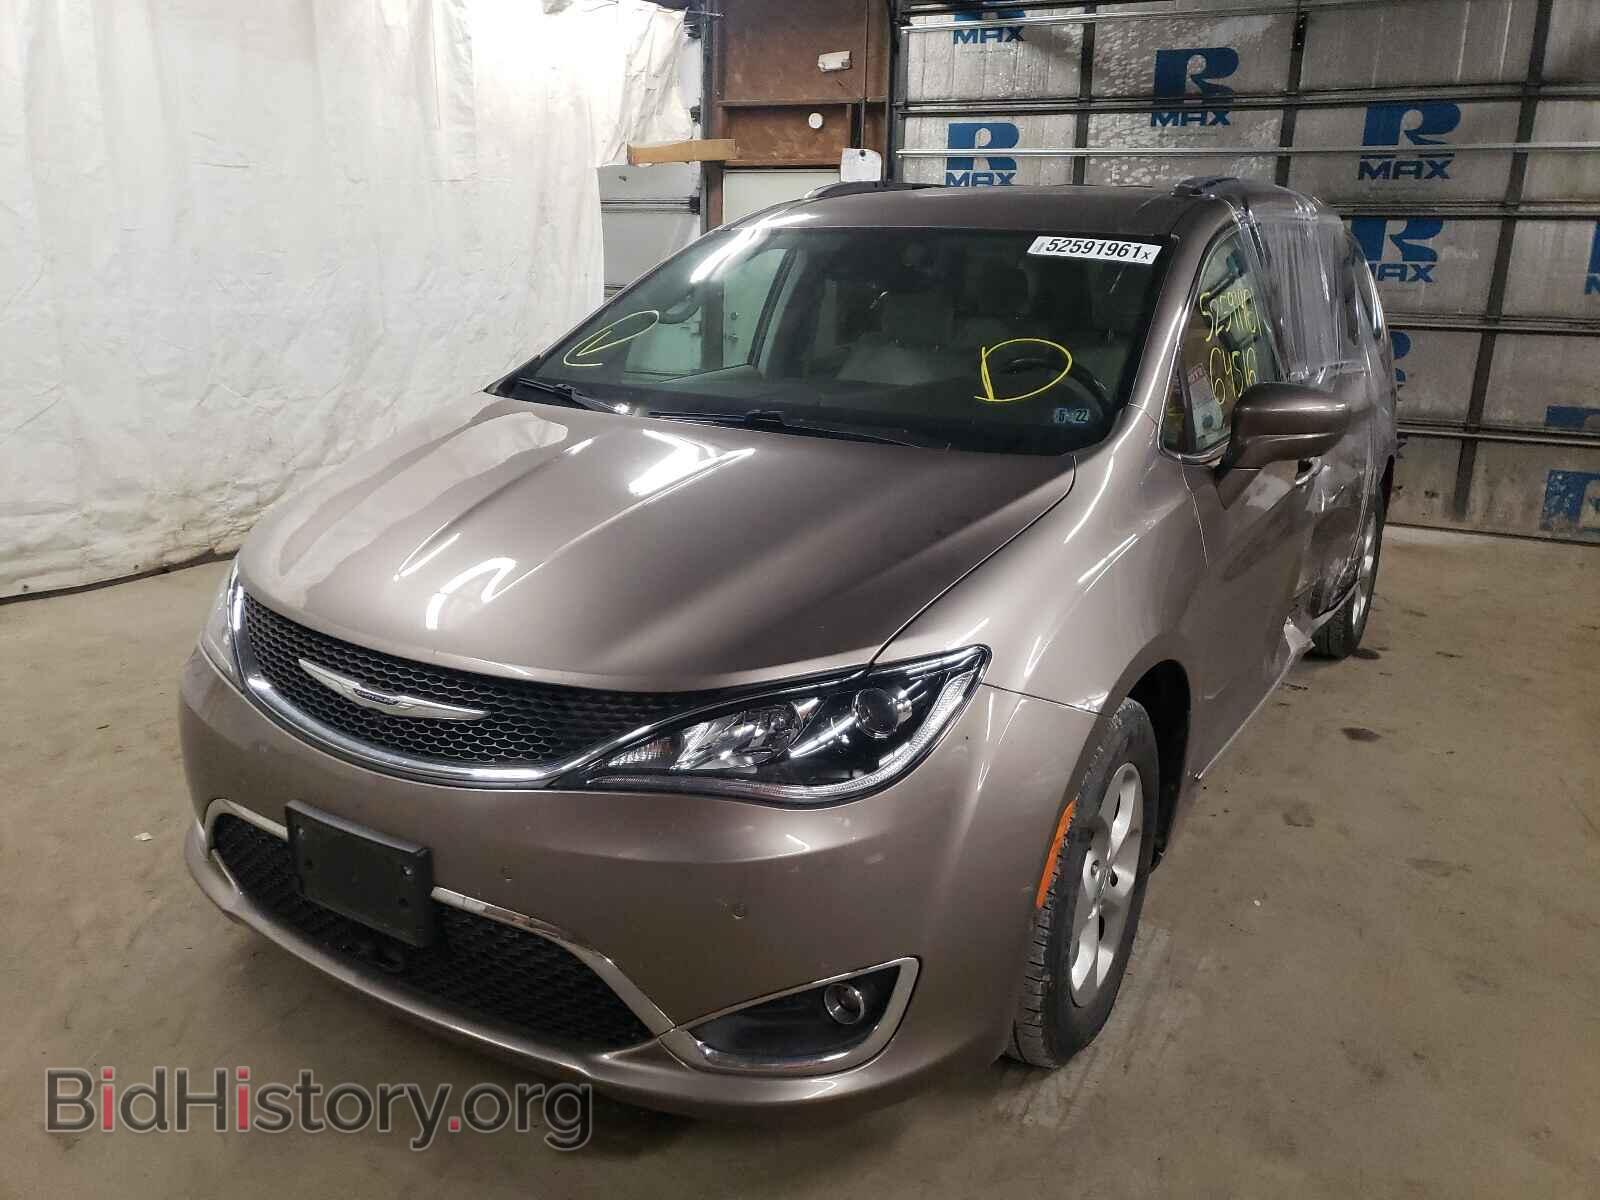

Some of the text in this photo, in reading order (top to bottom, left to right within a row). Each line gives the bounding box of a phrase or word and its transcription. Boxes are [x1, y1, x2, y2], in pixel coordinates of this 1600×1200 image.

[953, 26, 1025, 45] MAX
[1150, 111, 1232, 127] MAX
[1357, 160, 1454, 180] MAX
[945, 172, 1017, 187] MAX
